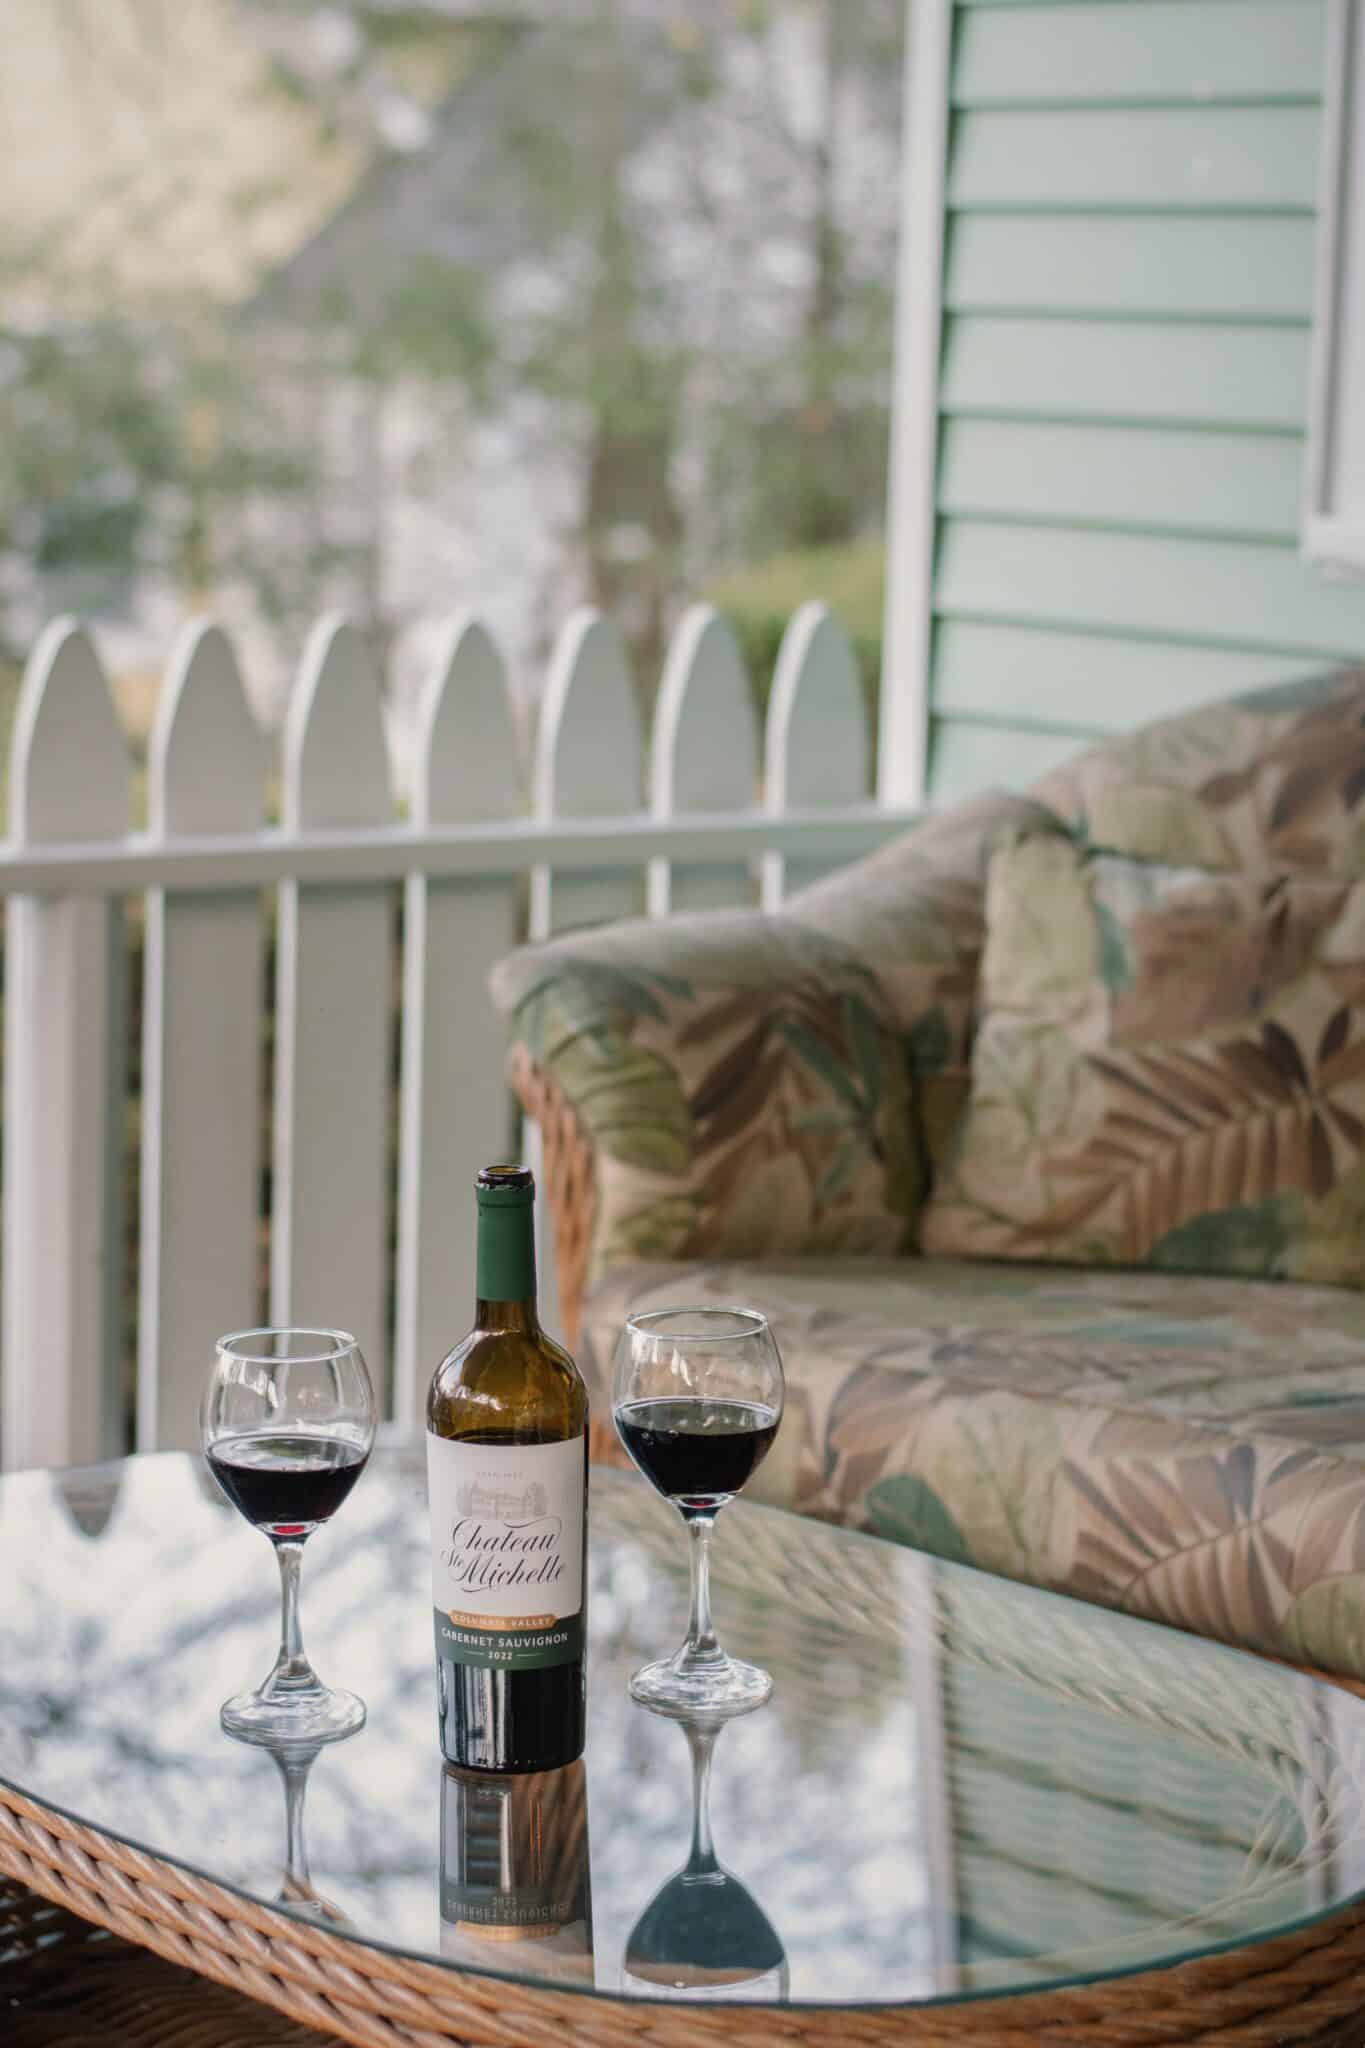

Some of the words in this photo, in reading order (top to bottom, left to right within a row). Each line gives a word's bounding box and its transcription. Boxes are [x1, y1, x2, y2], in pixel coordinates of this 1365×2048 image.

[453, 1518, 562, 1552] Chateau
[453, 1554, 566, 1593] Michelle
[511, 1617, 550, 1627] VALLEY
[441, 1627, 494, 1647] CABERNET
[498, 1632, 568, 1648] SAUVIGNON
[488, 1651, 513, 1660] 2022
